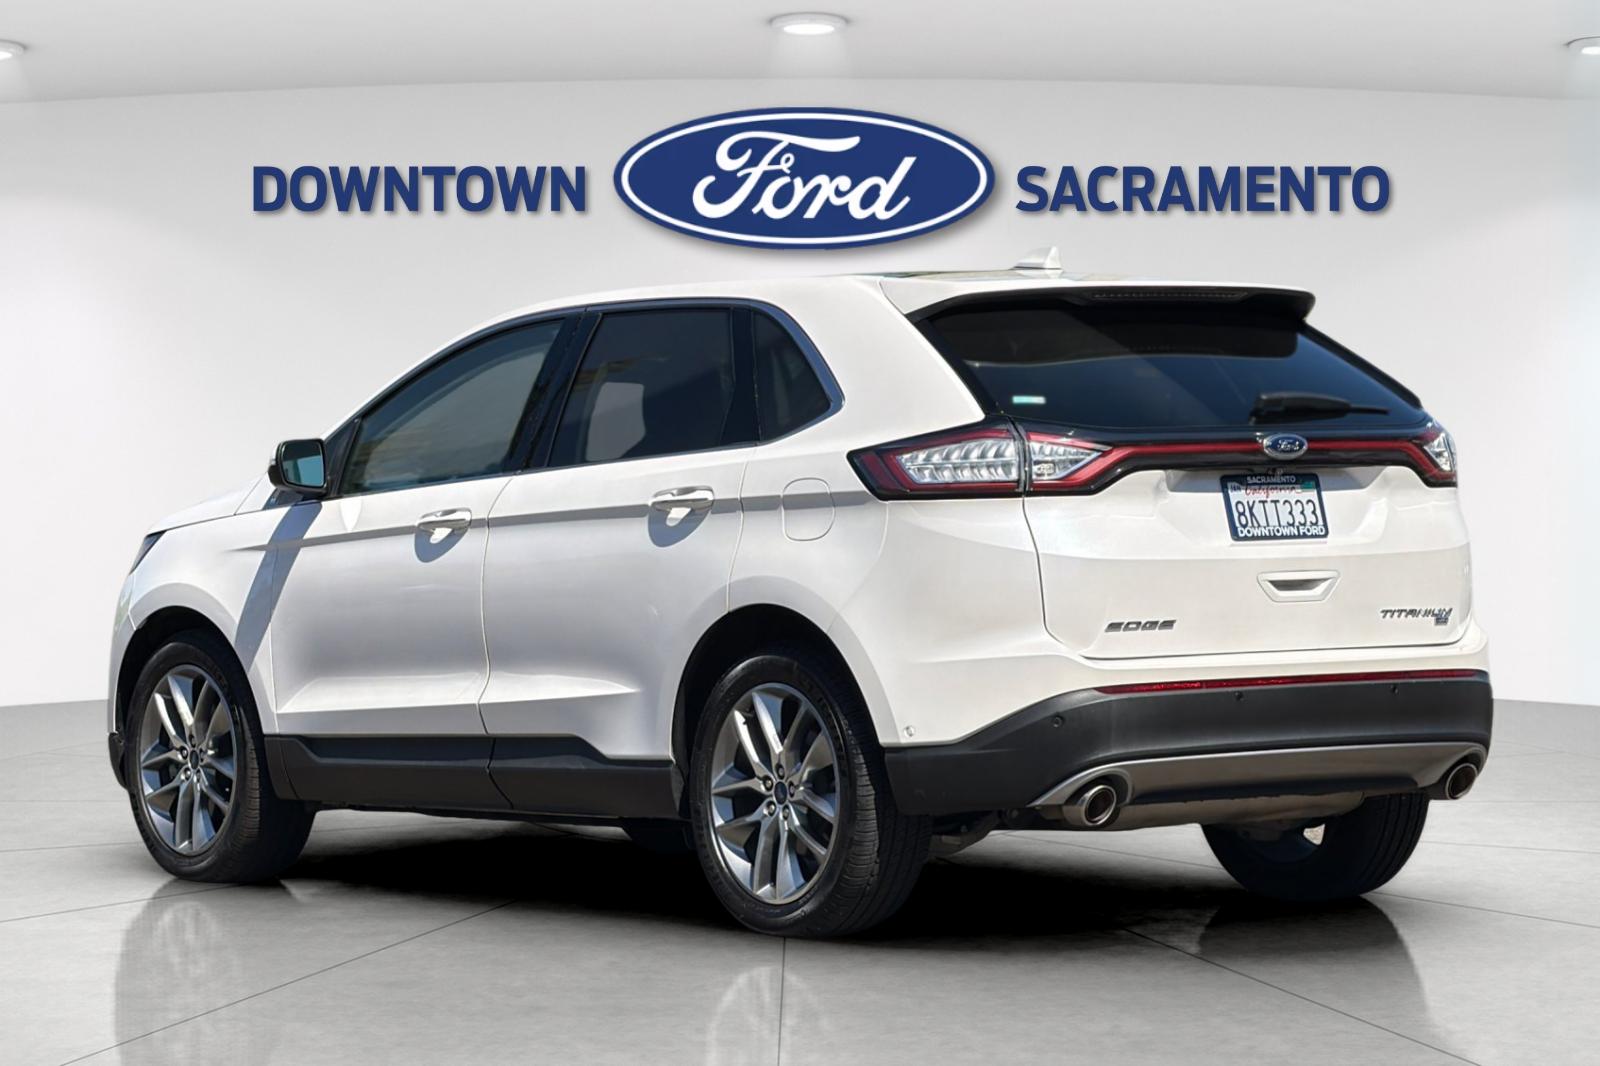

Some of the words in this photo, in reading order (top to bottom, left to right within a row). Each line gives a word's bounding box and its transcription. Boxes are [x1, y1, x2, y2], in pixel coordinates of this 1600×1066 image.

[252, 166, 587, 213] DOWNTOWN
[692, 130, 916, 220] Ford
[1016, 165, 1391, 213] SACRAMENTO
[1246, 475, 1296, 484] SACRAMENTO
[1235, 499, 1319, 528] 8KTT333
[1237, 526, 1298, 537] DOWNTOWN
[1299, 525, 1326, 536] FORD
[1379, 607, 1454, 619] TITANIUM
[1104, 619, 1177, 633] EDGE
